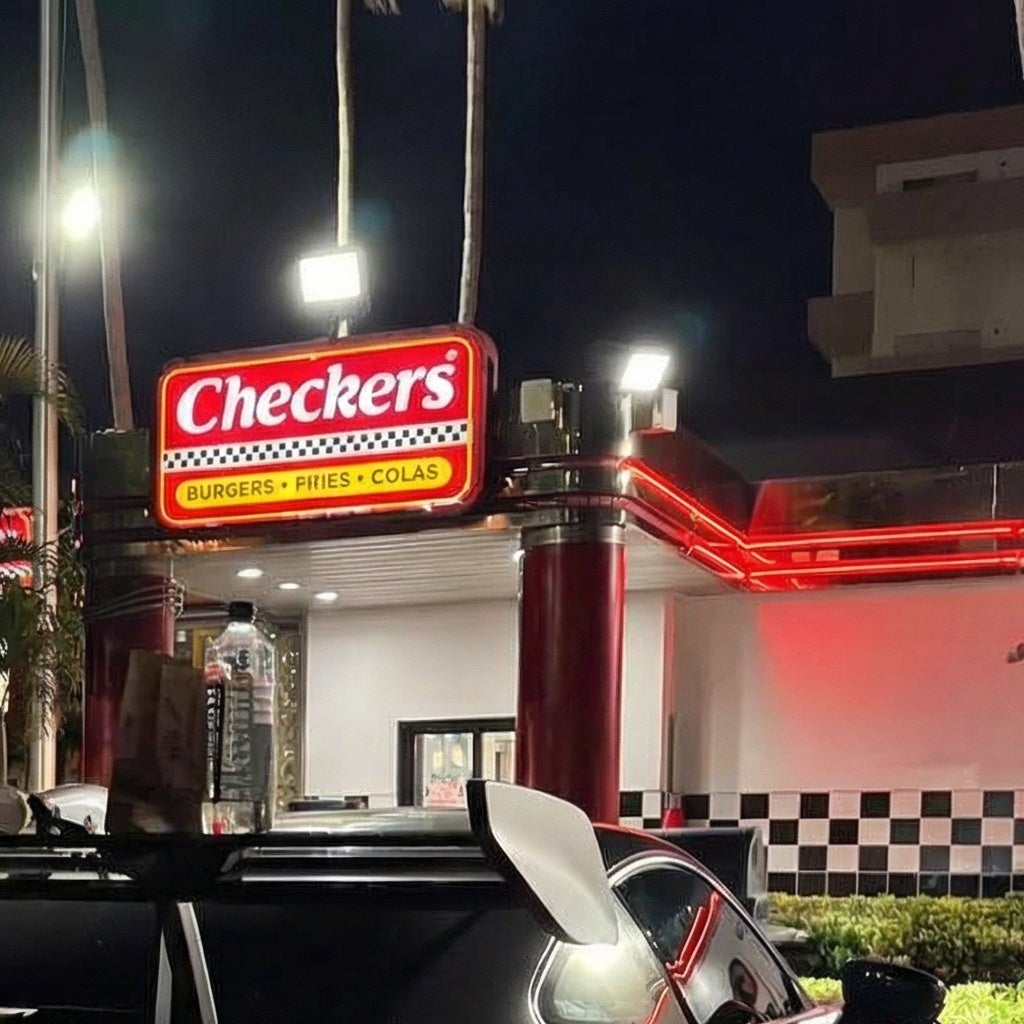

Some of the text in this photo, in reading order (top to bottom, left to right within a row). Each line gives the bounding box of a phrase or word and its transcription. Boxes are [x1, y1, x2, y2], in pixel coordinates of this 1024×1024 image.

[176, 362, 457, 435] Checkers
[186, 480, 274, 502] BURGERS
[371, 464, 439, 485] COLAS
